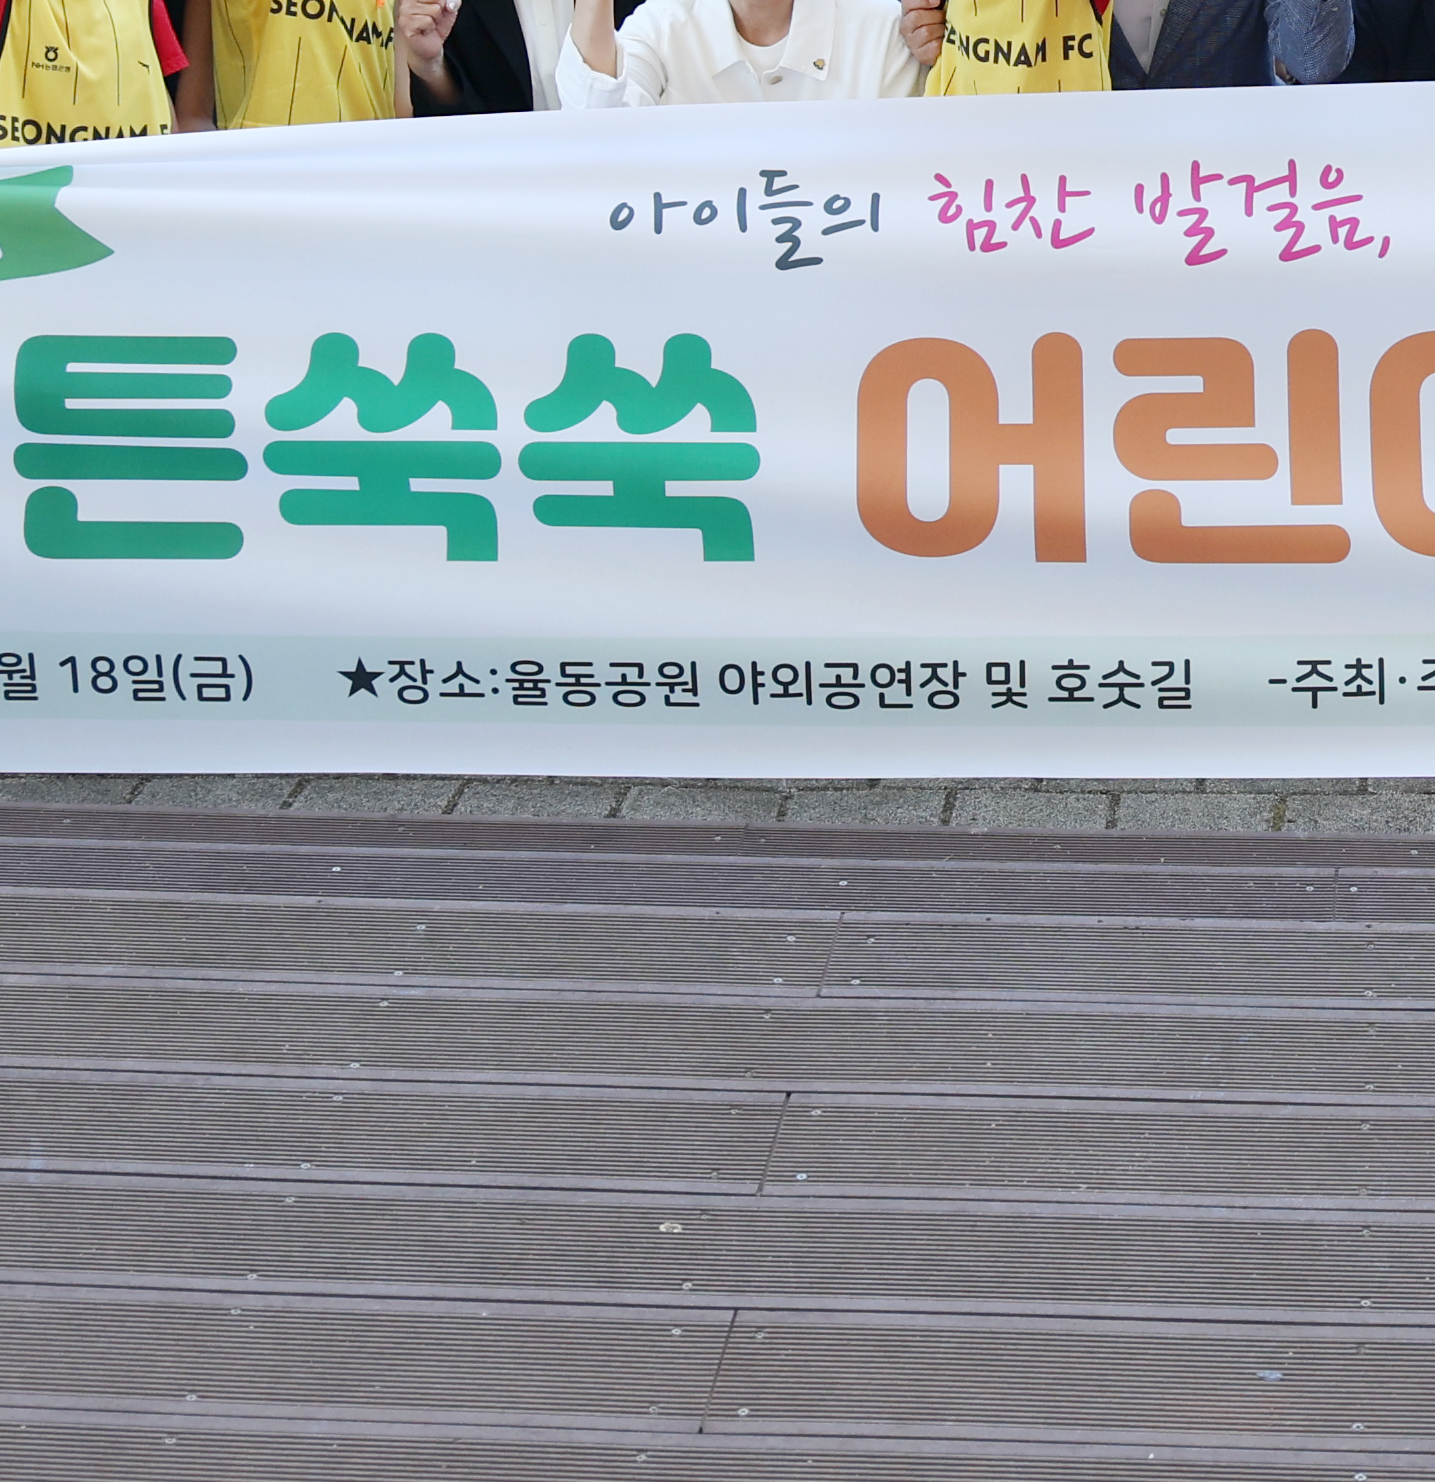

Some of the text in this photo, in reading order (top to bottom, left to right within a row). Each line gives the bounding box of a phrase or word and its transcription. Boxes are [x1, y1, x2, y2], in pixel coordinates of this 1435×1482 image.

[1063, 33, 1094, 61] FC
[609, 169, 881, 271] 아이들의
[927, 173, 1095, 253] 힘찬
[1134, 159, 1391, 267] 발걸음,
[59, 653, 254, 703] 18일(금)
[717, 659, 967, 710] 야외공연장
[985, 659, 1028, 710] 및
[1047, 658, 1192, 710] 호숫길
